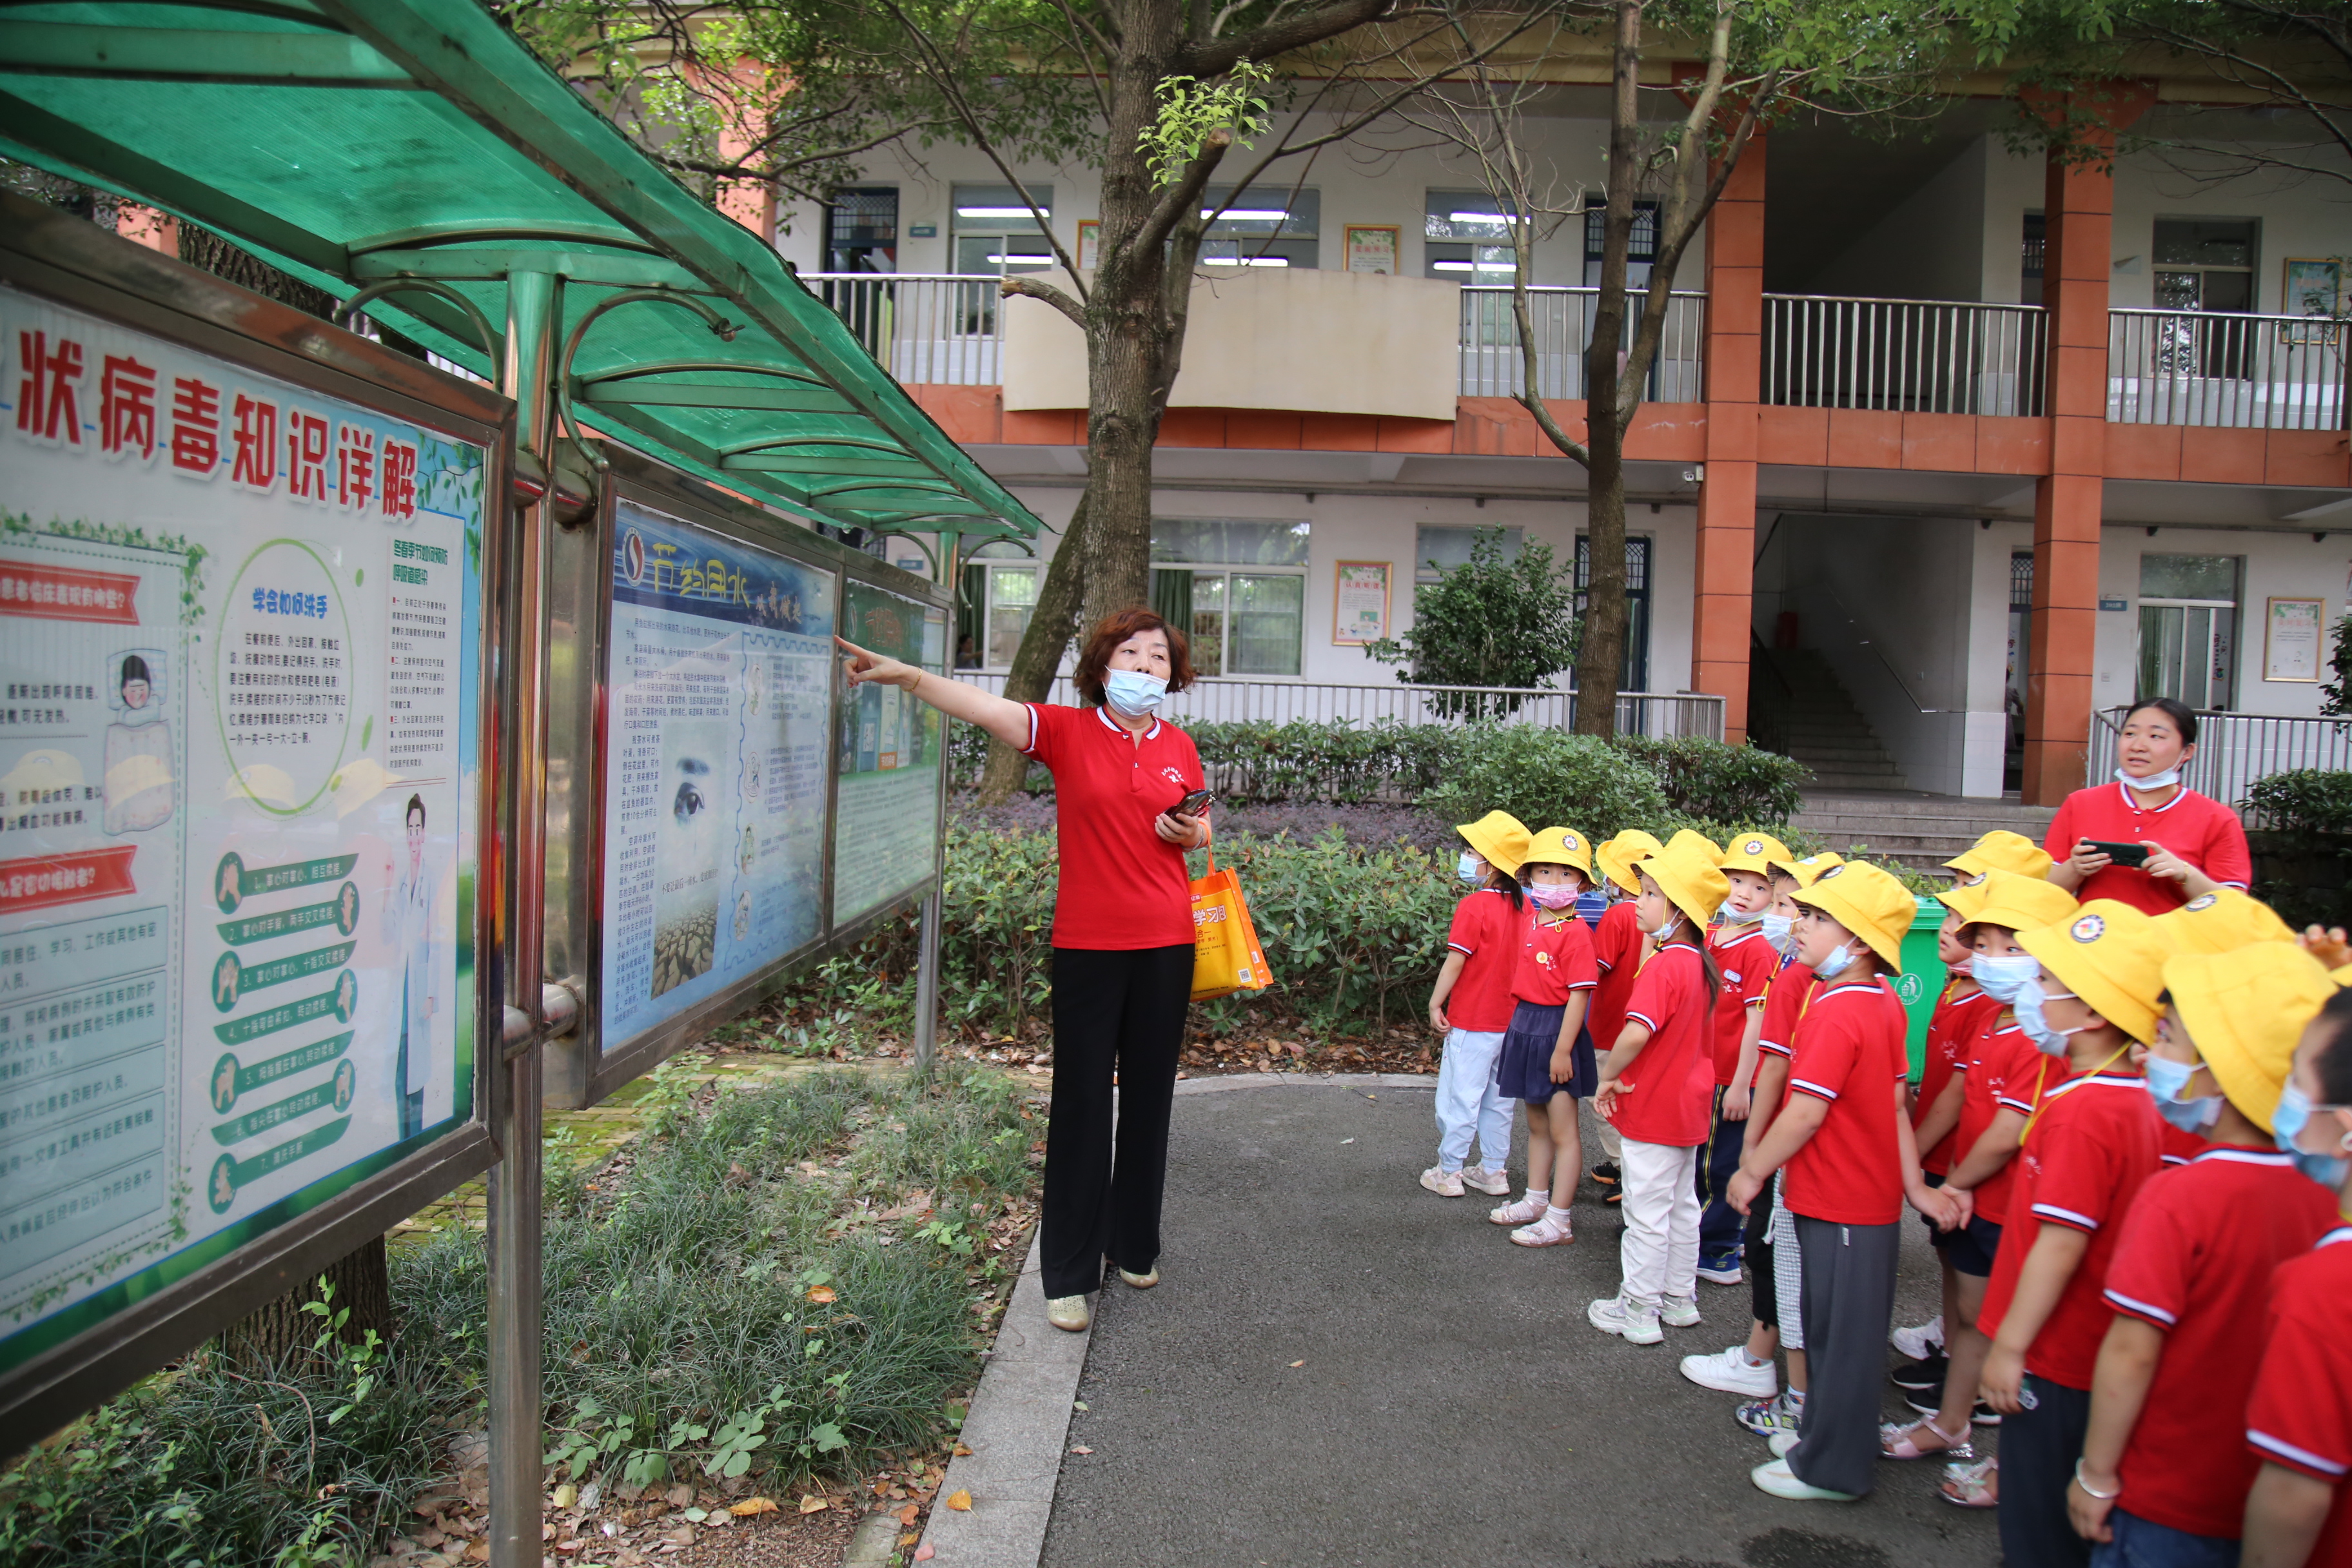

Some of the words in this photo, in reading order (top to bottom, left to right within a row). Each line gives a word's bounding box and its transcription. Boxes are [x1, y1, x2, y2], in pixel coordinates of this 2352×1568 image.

[17, 329, 418, 520] 状病毒知识详解
[394, 539, 448, 565] 冬春季节如何预防
[393, 564, 428, 585] 呼吸道感染
[652, 542, 750, 609] 节约用水
[253, 587, 328, 620] 学会如何洗手
[1193, 905, 1226, 926] 学习包
[1196, 930, 1211, 939] 合一
